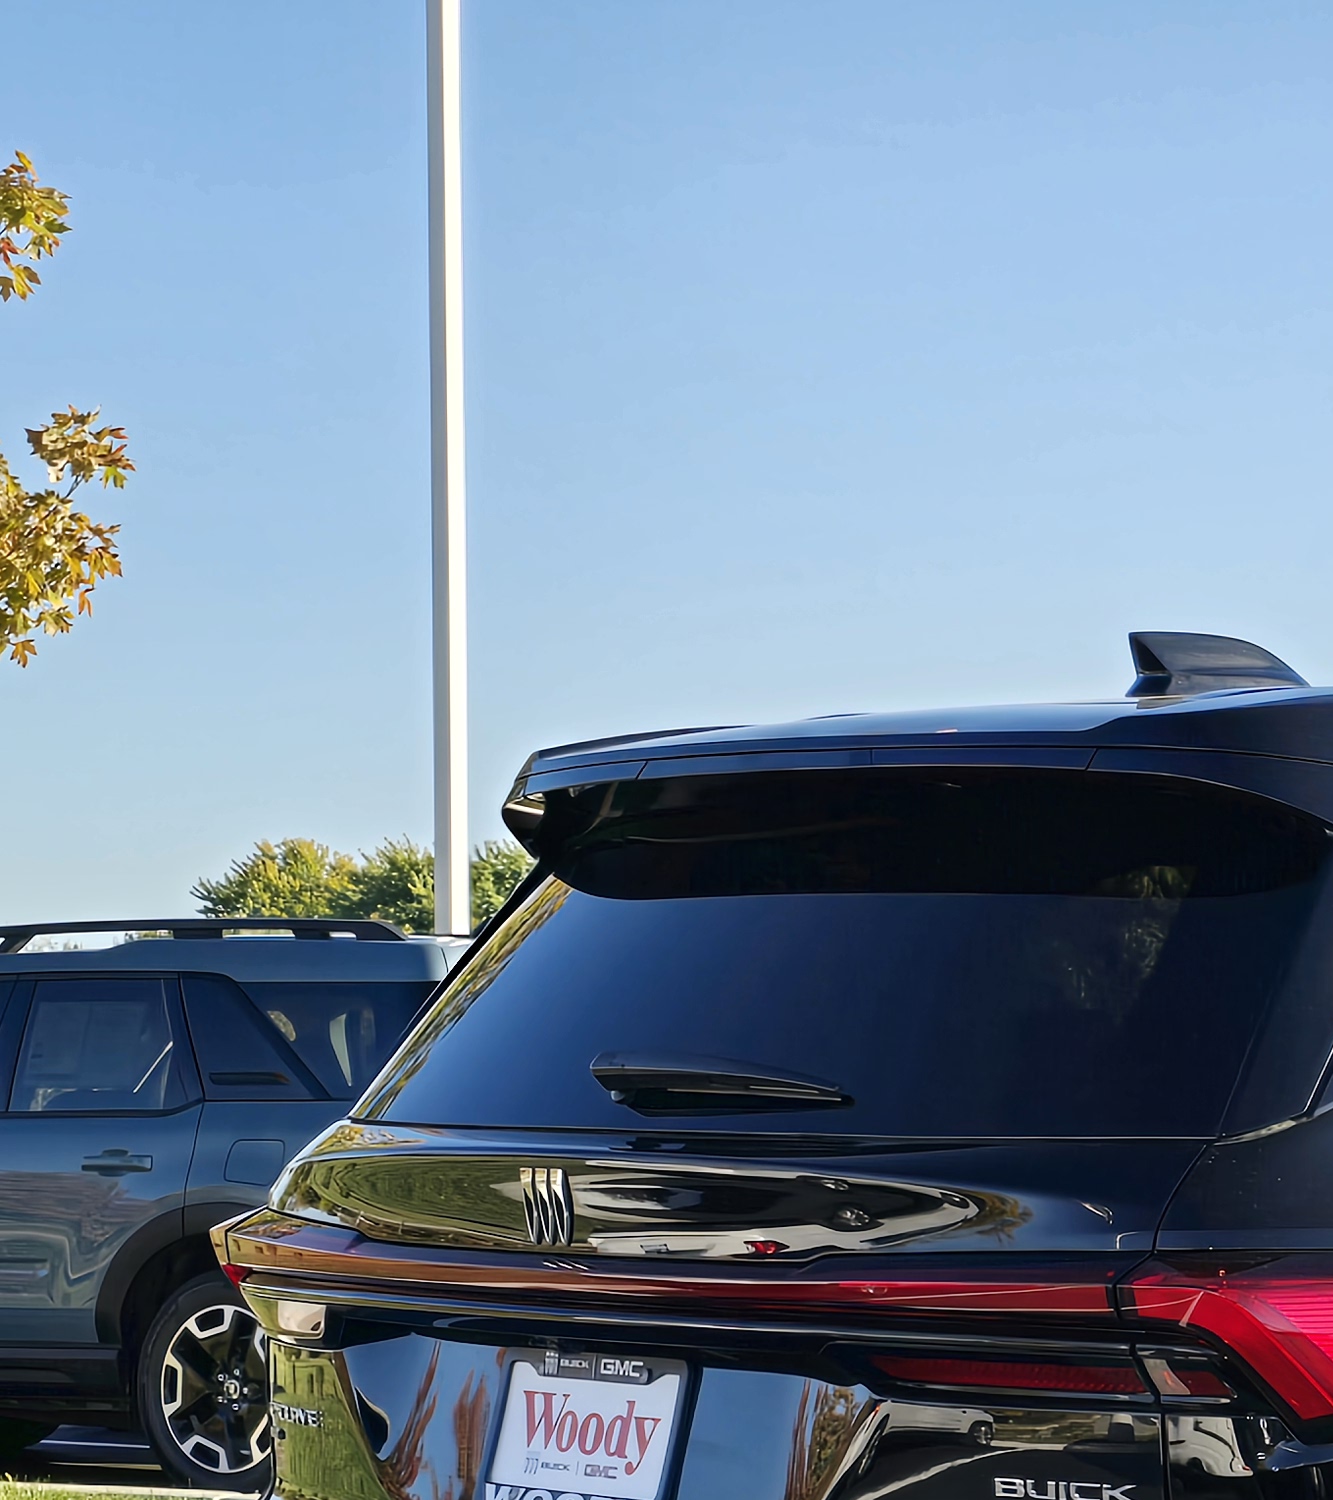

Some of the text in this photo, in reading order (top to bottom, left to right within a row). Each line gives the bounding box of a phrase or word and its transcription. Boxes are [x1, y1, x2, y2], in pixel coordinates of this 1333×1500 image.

[600, 1358, 644, 1378] GMC
[523, 1390, 662, 1476] Woody
[584, 1463, 618, 1479] GMC
